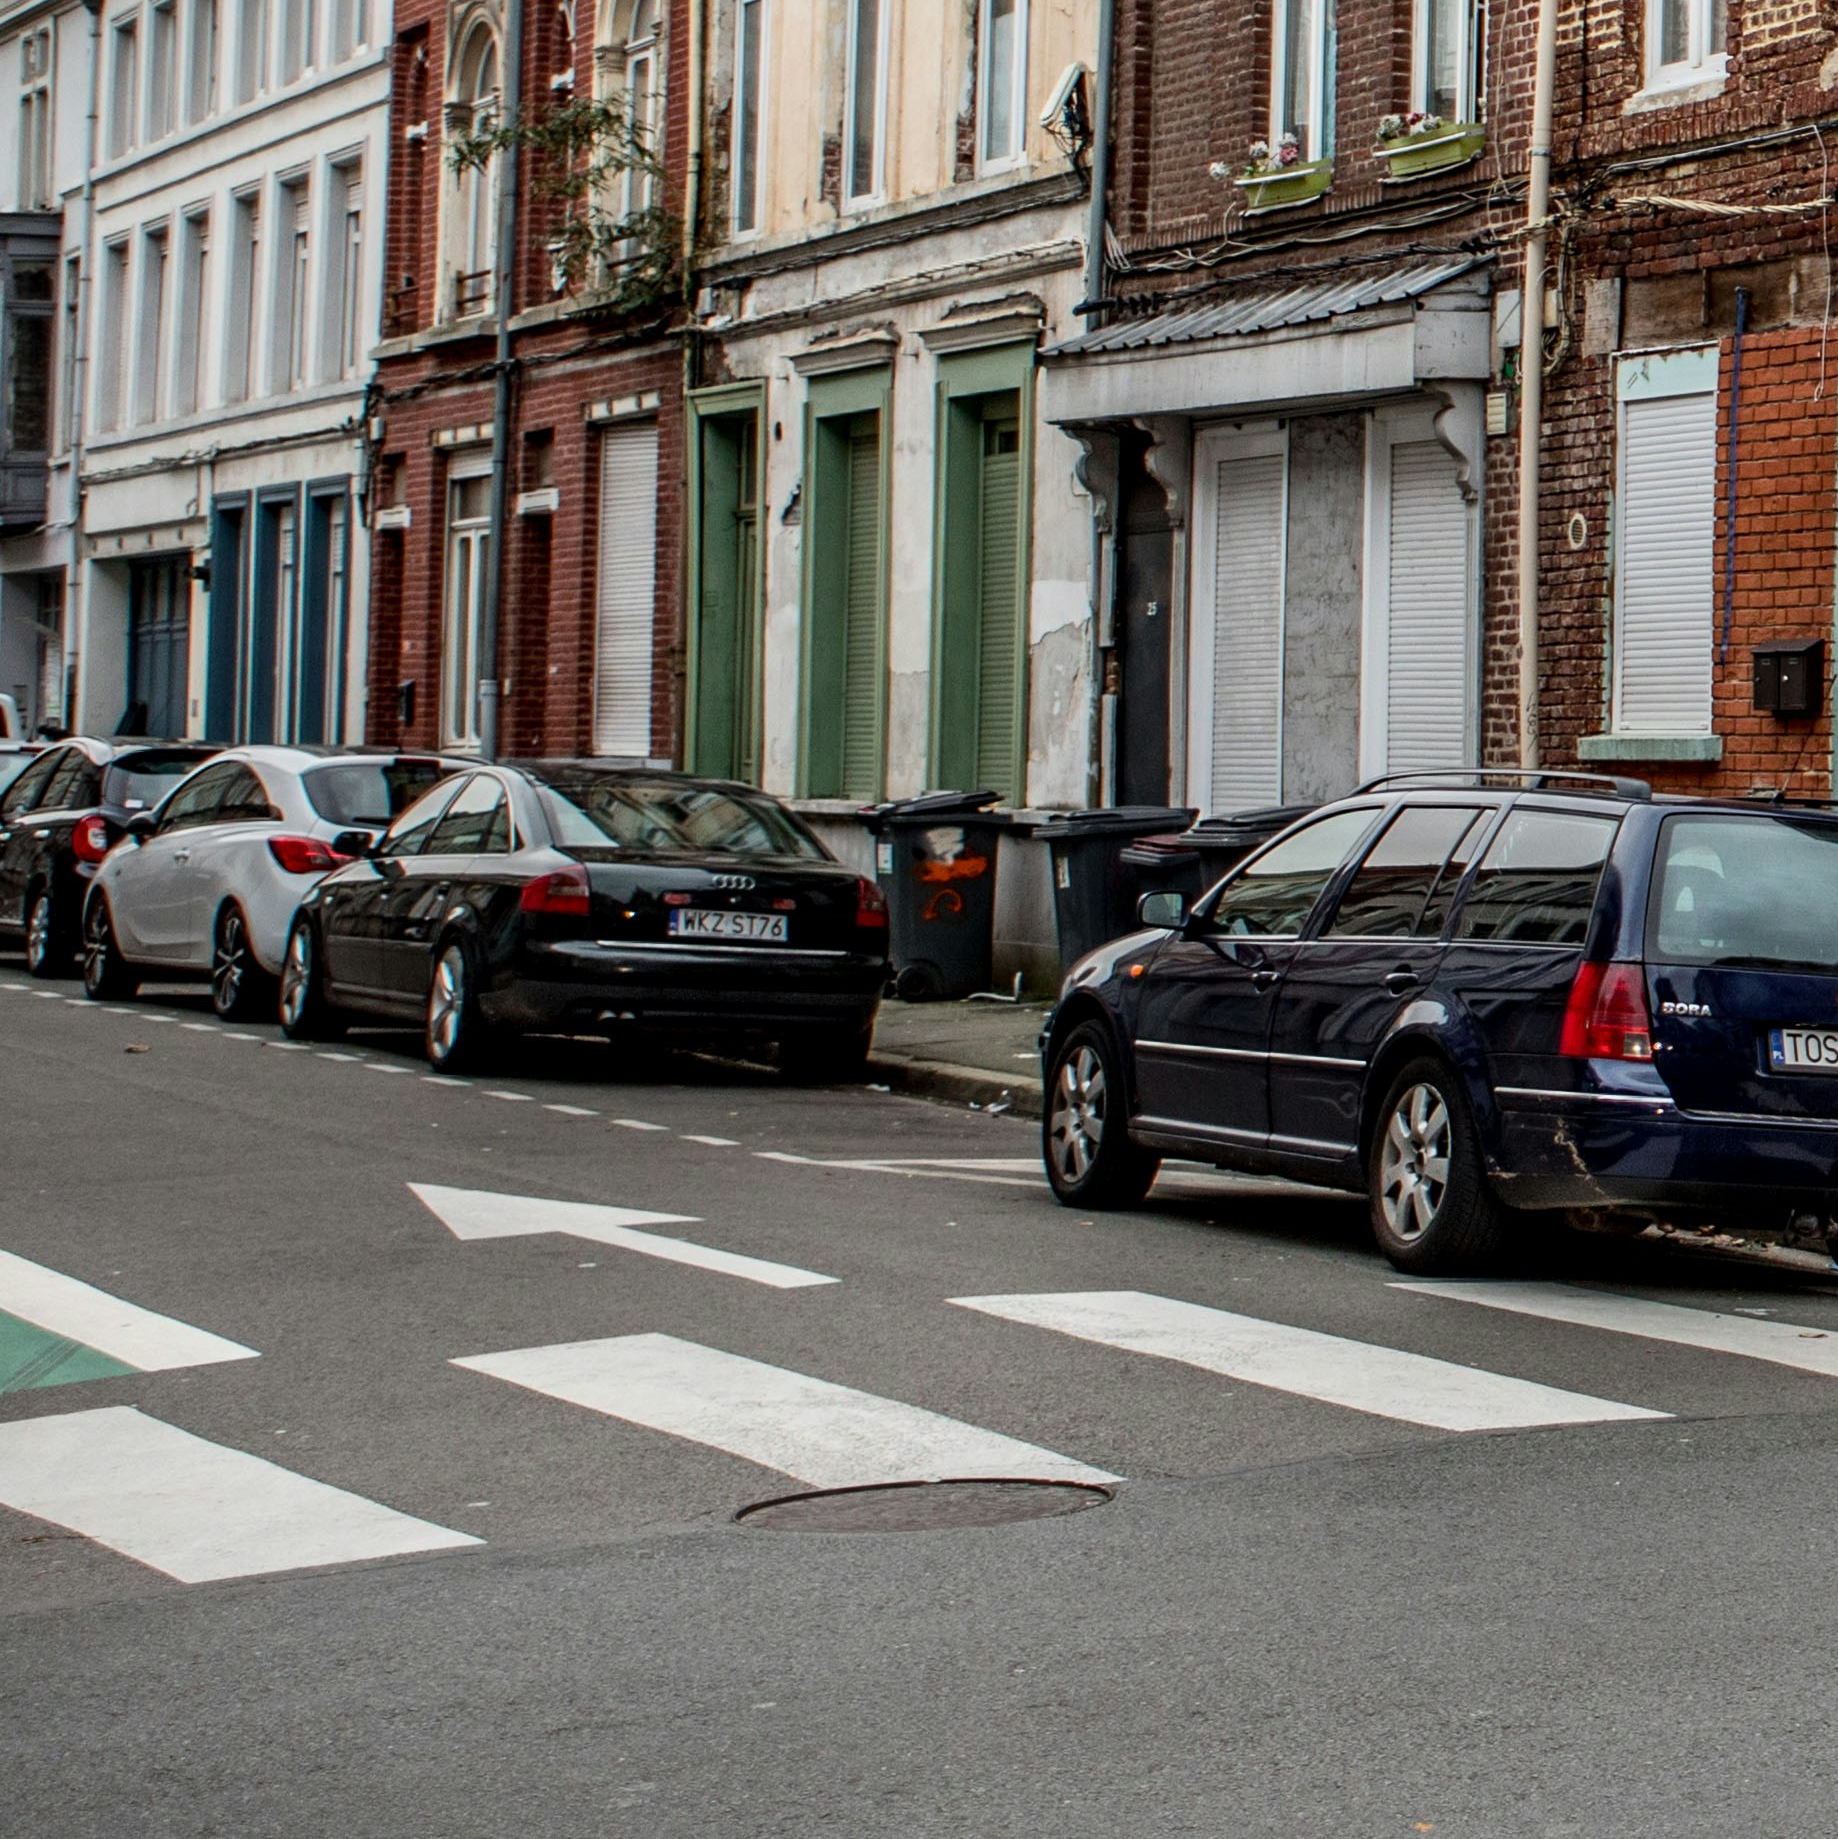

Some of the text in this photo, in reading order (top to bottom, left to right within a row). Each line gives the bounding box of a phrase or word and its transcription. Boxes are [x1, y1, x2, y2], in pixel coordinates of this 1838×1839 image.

[684, 911, 783, 937] WKZ ST76
[1662, 1001, 1712, 1017] BORA
